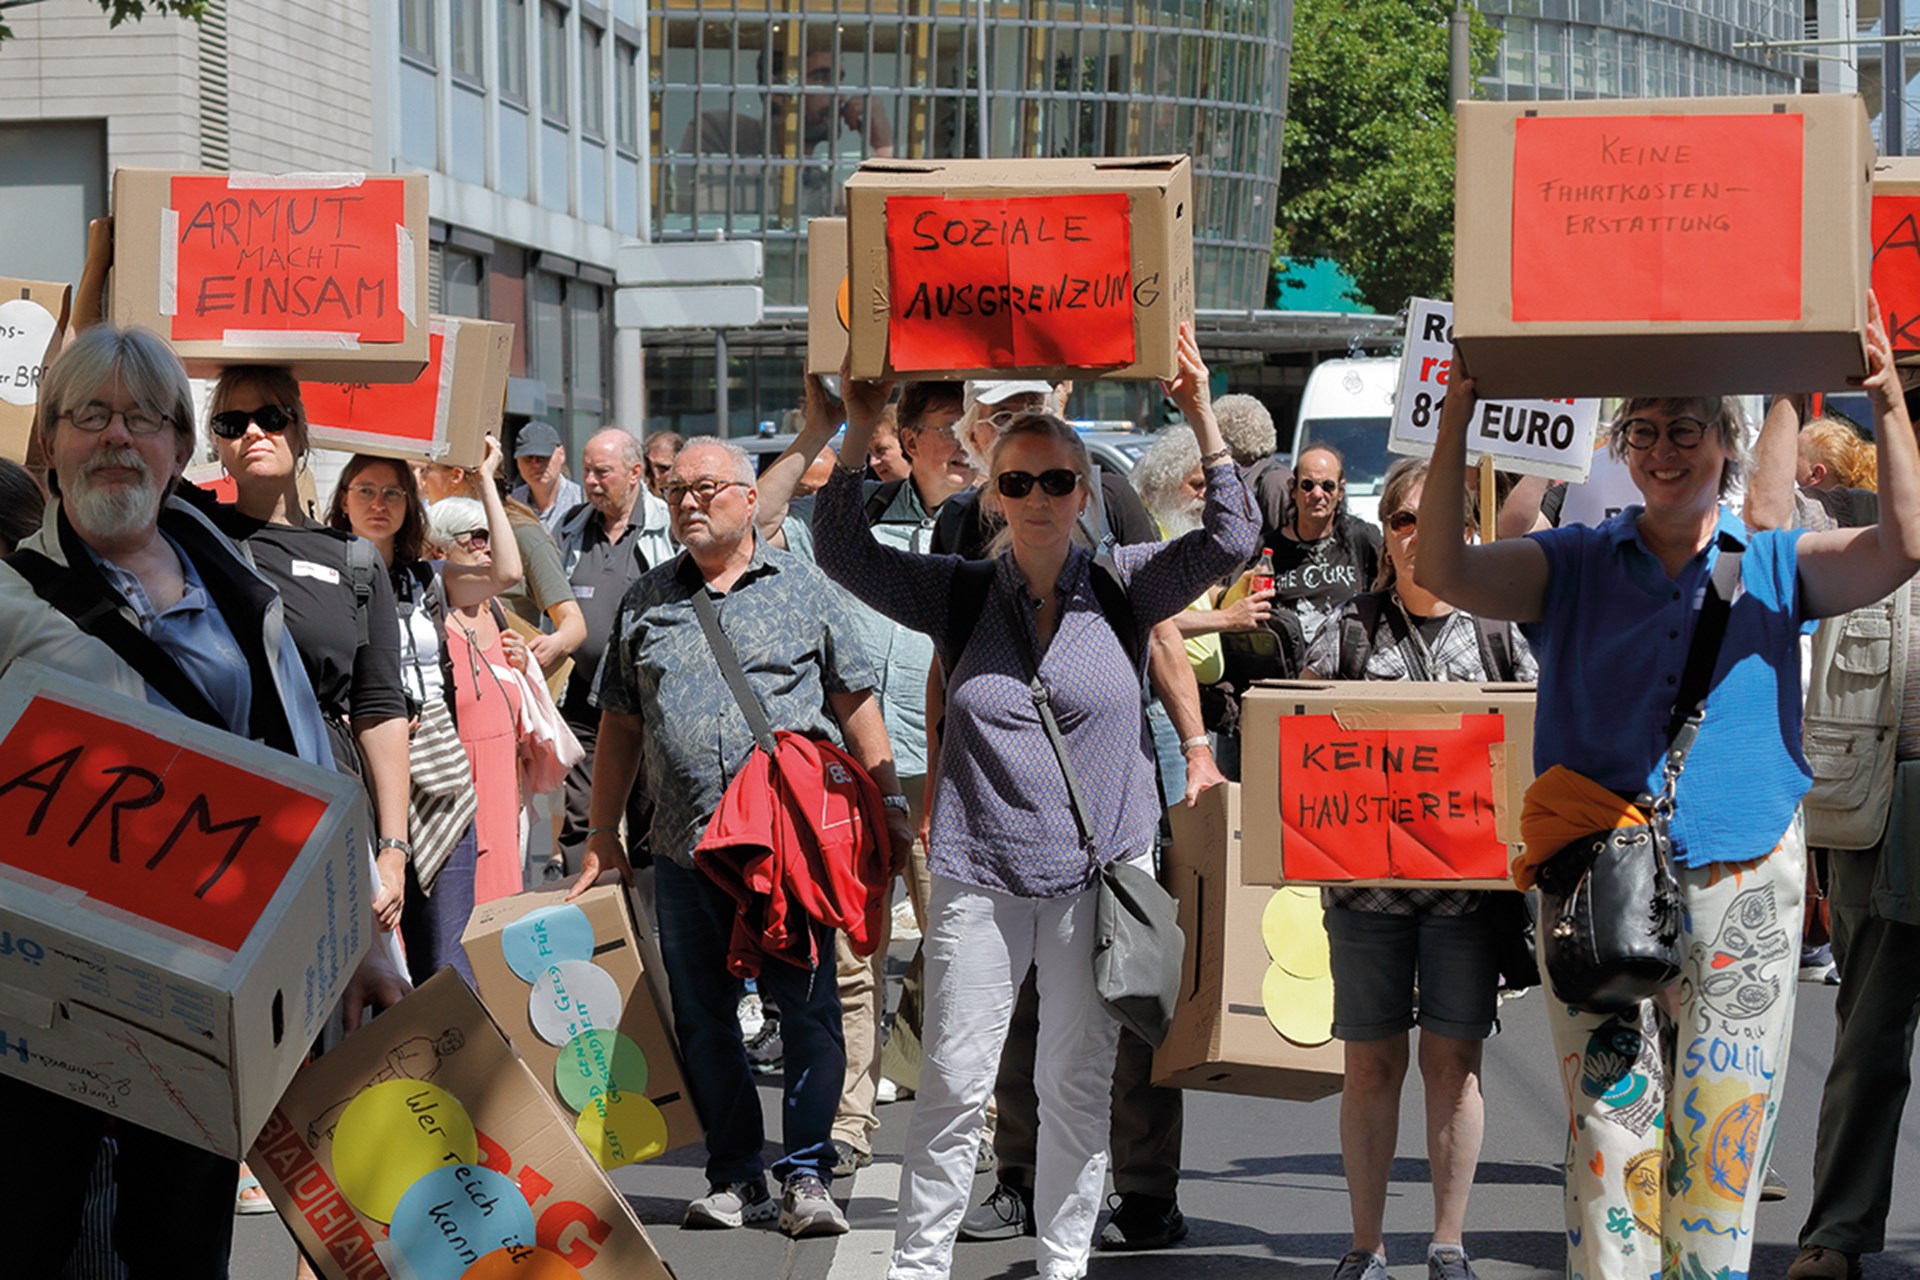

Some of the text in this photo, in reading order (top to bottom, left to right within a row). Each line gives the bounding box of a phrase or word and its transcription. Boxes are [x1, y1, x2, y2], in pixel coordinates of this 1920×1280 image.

[1601, 133, 1691, 165] KEINE
[181, 195, 364, 249] ARMUT
[913, 211, 1092, 251] SOZIALE
[1566, 214, 1730, 236] ERSTATTUNG
[236, 244, 361, 272] MACHT
[195, 275, 385, 320] EINSAM
[903, 272, 1160, 320] AUSGRENZUNG
[1480, 402, 1574, 451] EURO
[1302, 739, 1440, 773] KEINE
[0, 745, 262, 899] ARM
[531, 919, 552, 957] FÜR
[567, 1022, 592, 1079] GENUG
[405, 1090, 534, 1265] Wer reich ist
[428, 1200, 479, 1266] kann
